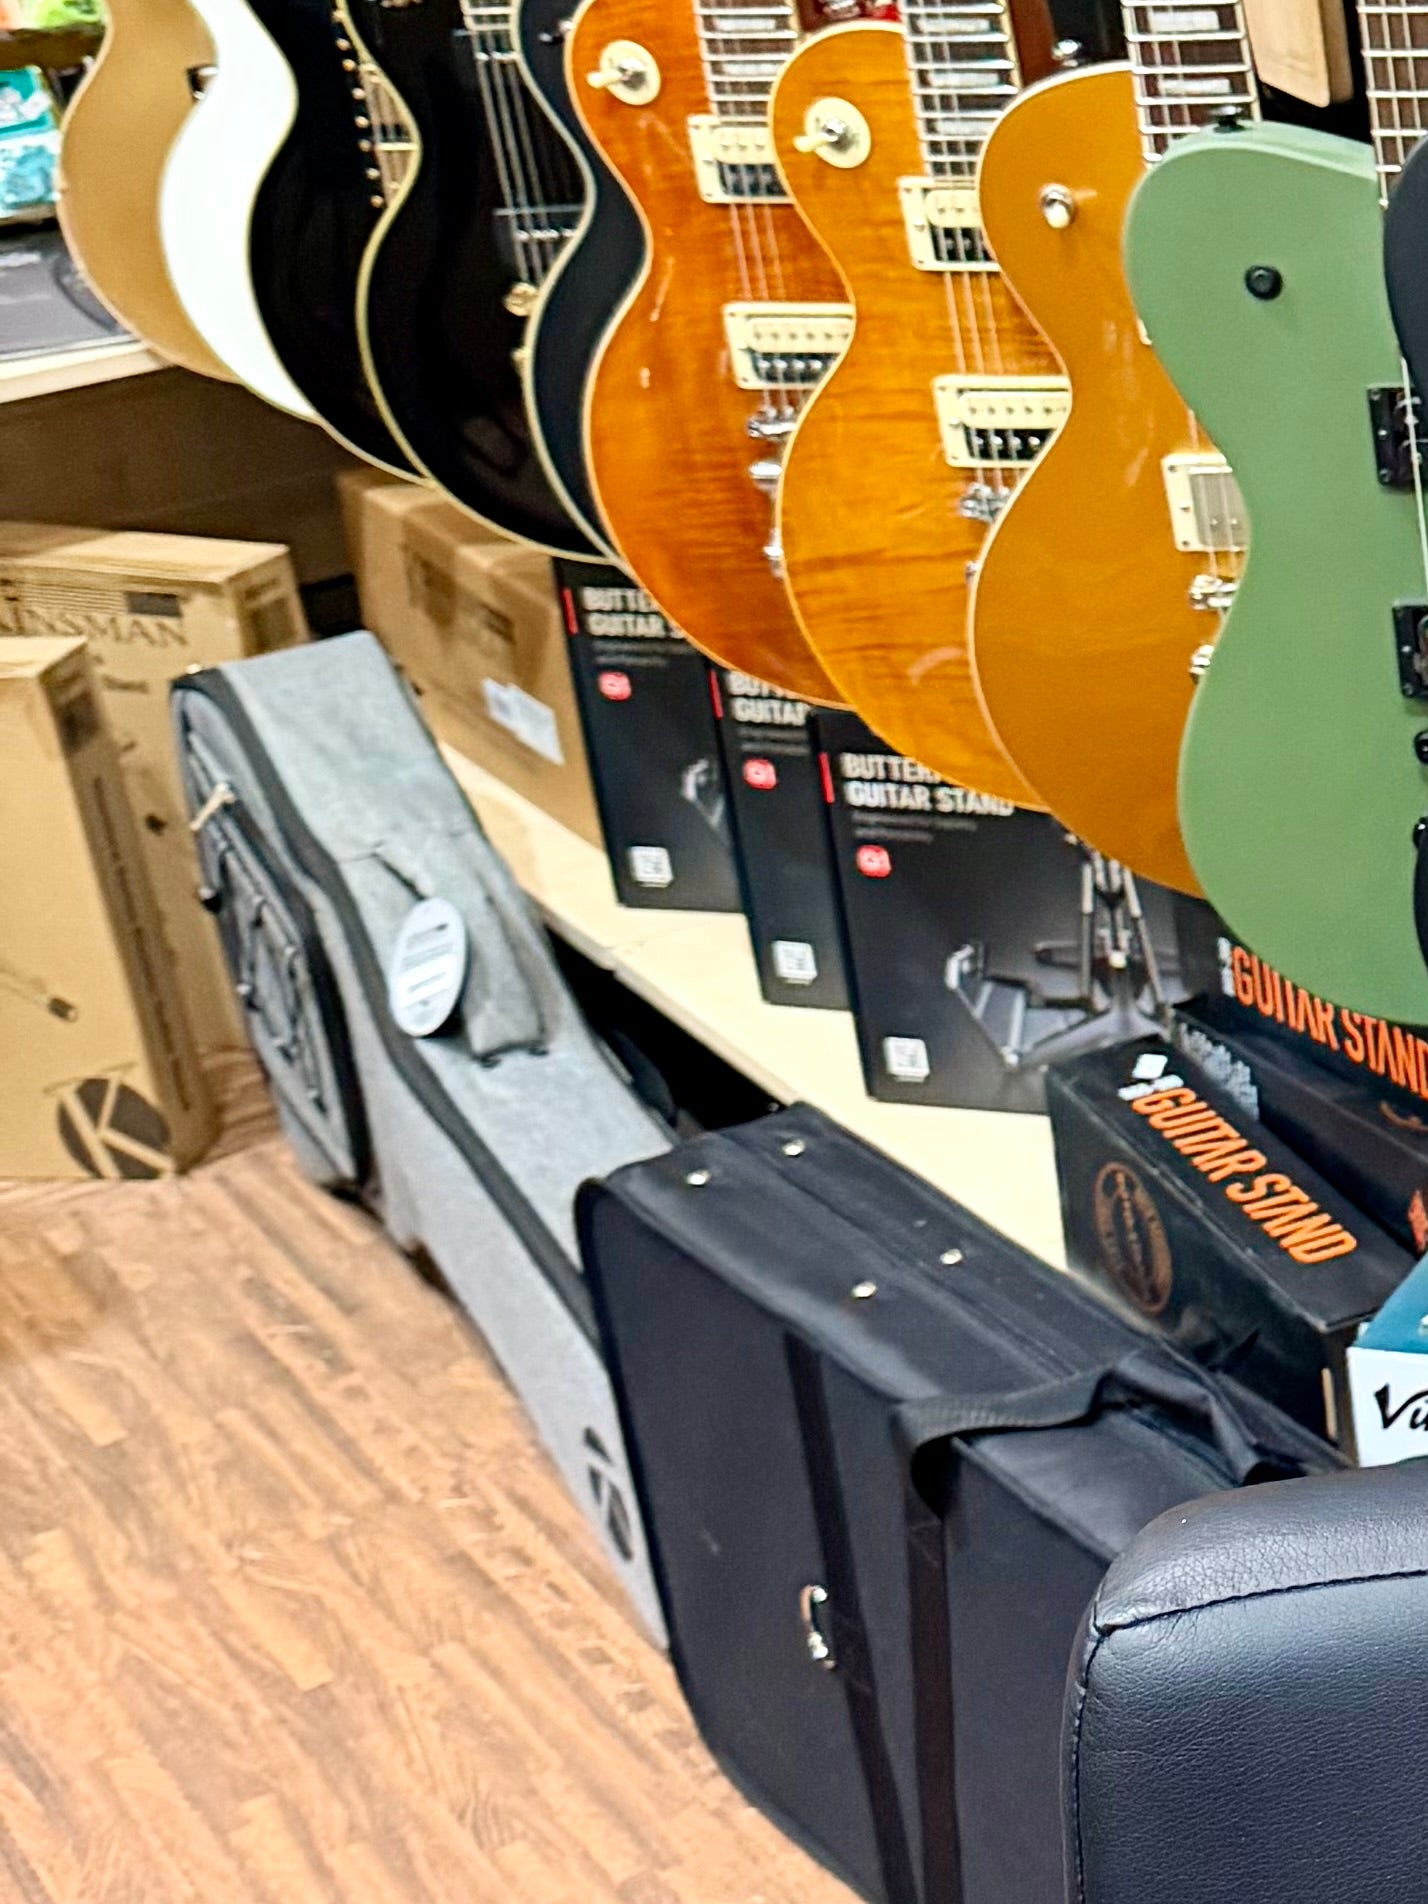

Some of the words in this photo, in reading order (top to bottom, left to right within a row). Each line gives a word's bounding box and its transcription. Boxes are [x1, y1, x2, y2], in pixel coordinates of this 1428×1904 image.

[843, 780, 932, 811] GUITAR
[1231, 946, 1341, 1053] GUITAR
[1130, 1087, 1268, 1184] GUITAR
[1225, 1172, 1358, 1265] STAND
